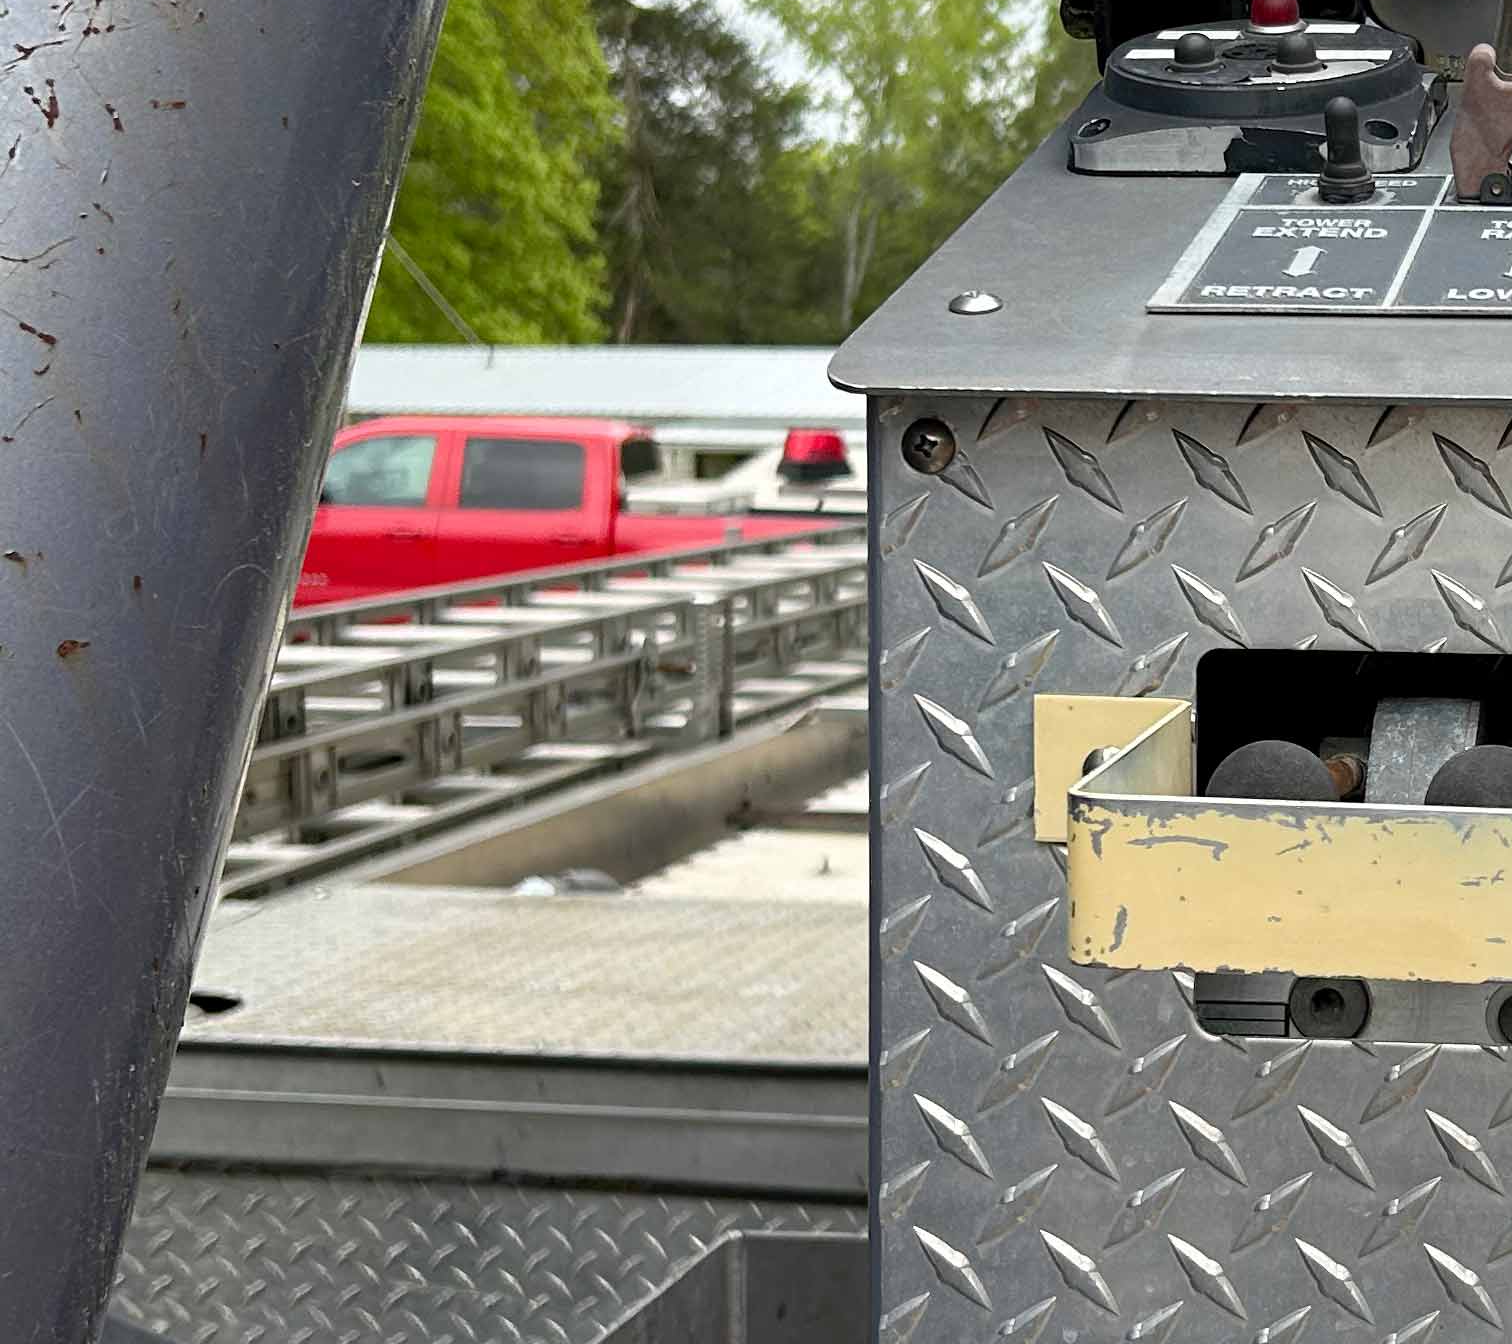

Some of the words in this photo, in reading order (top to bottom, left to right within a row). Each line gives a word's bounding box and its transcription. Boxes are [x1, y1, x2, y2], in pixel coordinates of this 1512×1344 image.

[1281, 218, 1372, 229] TOWER
[1251, 226, 1389, 240] EXTEND
[1200, 286, 1374, 301] RETRACT
